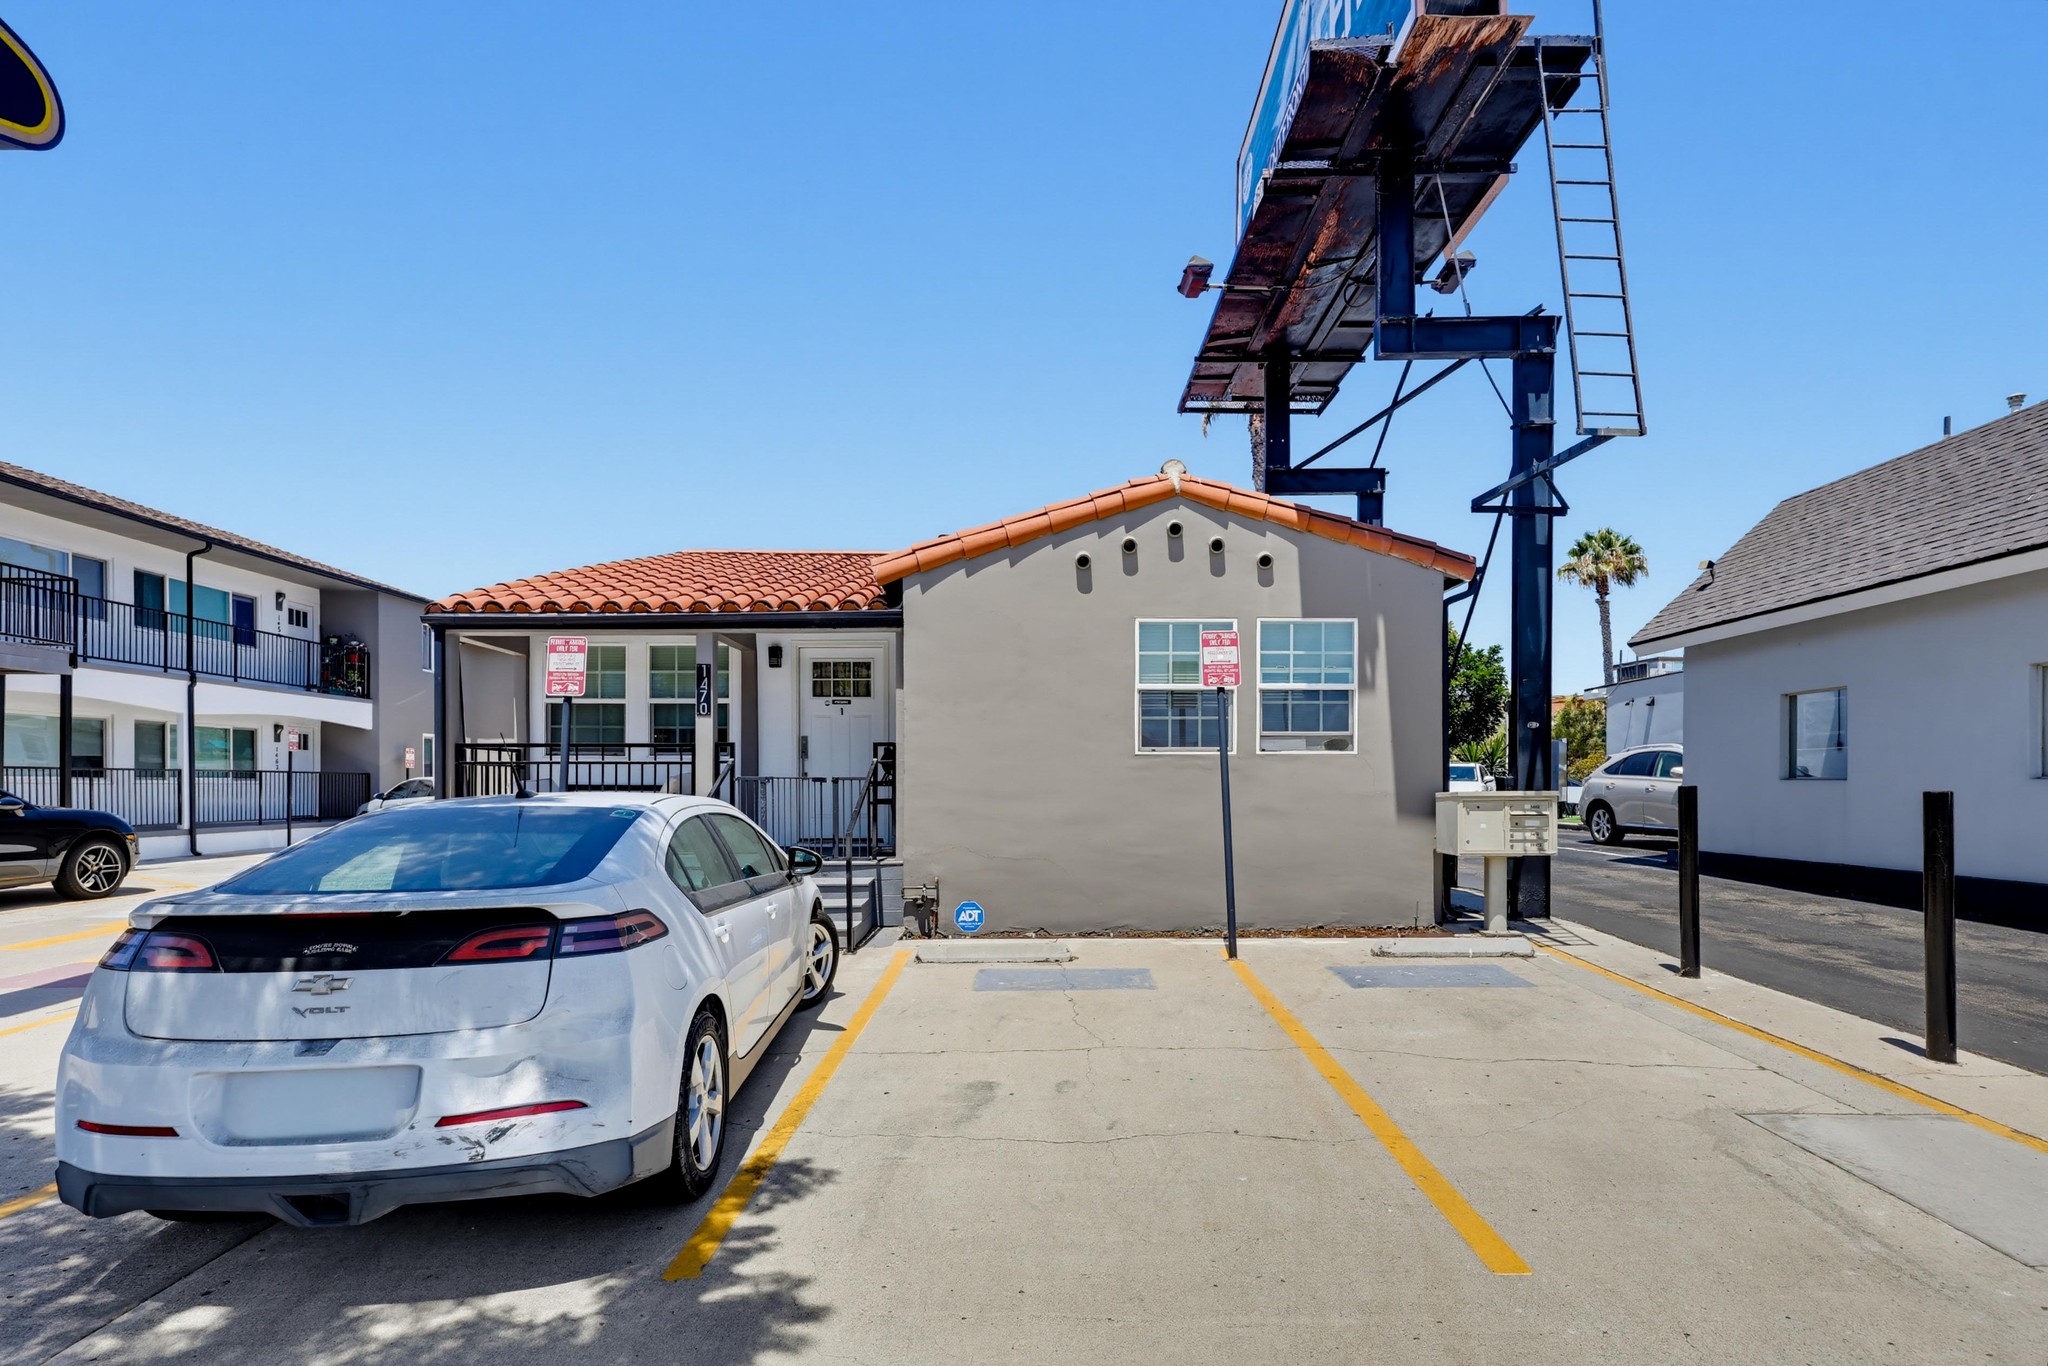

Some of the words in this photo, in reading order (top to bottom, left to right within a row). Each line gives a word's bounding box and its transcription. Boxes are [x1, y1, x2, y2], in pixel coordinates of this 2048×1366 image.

[840, 707, 844, 716] 1
[958, 910, 982, 922] ADT
[292, 1006, 351, 1018] VOLT
